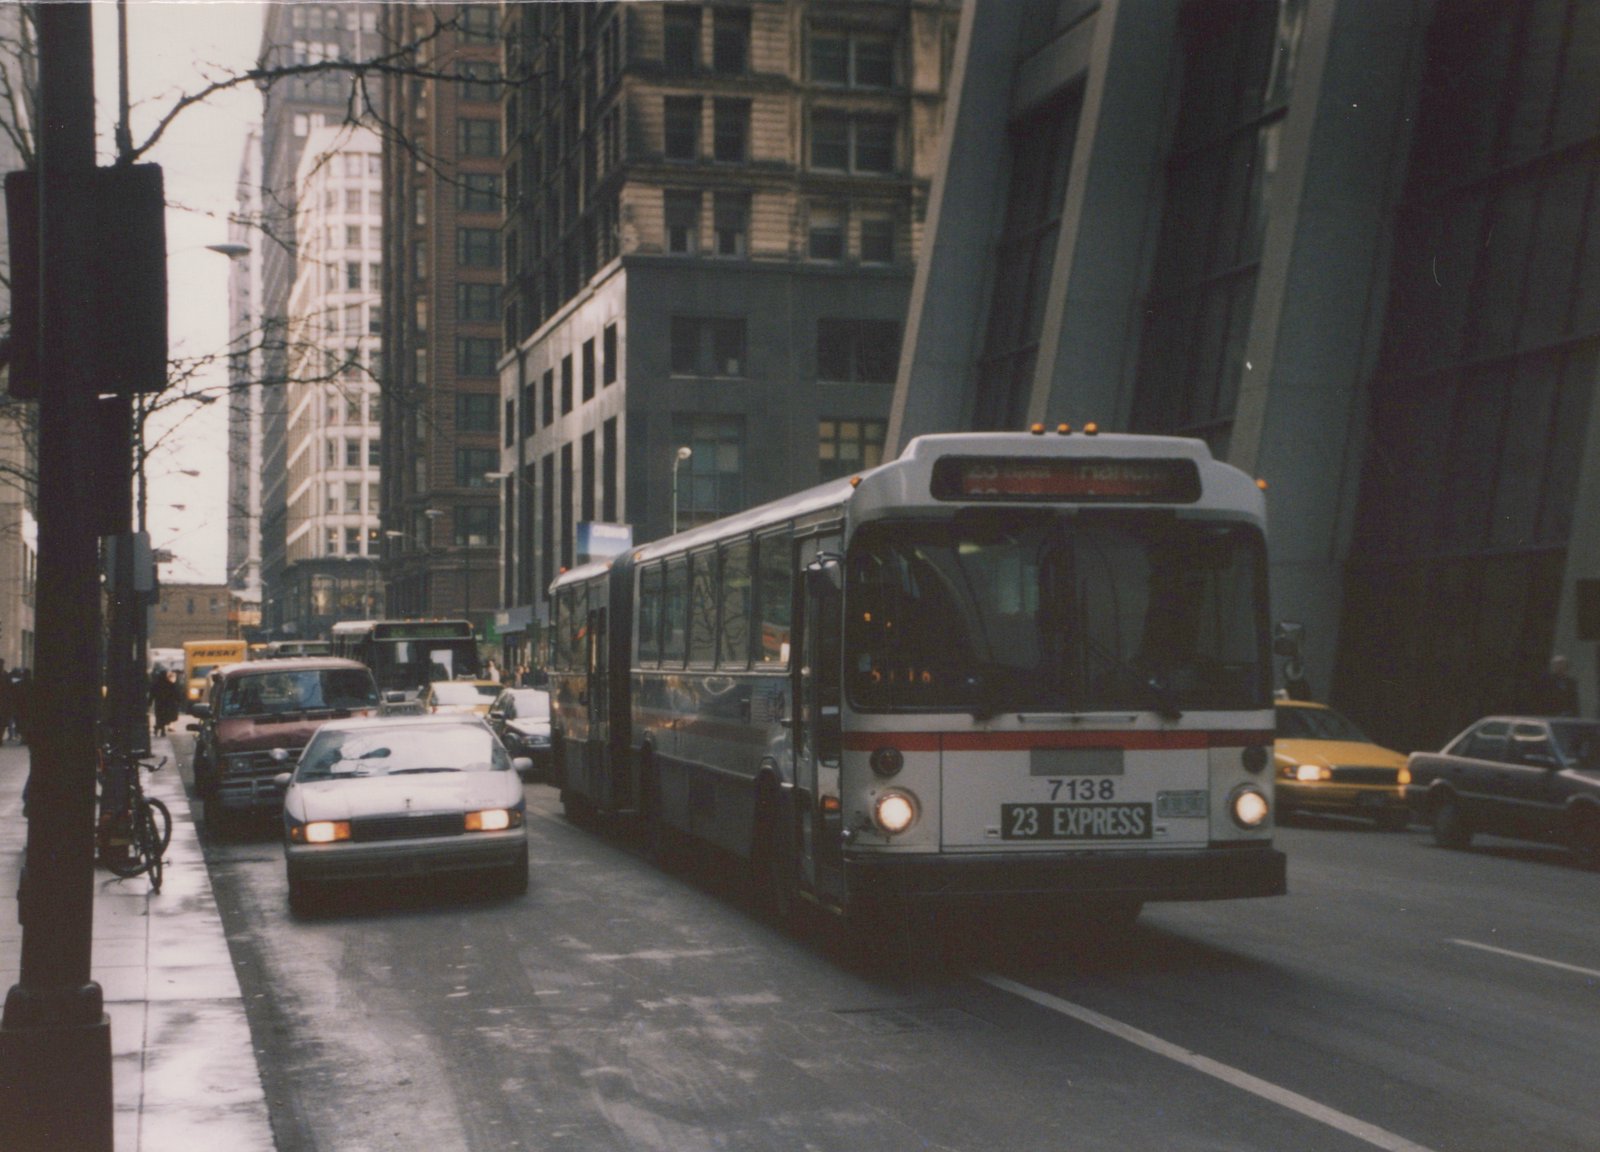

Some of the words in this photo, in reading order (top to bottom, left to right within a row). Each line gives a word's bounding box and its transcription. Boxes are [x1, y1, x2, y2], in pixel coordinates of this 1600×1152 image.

[1048, 779, 1115, 800] 7138
[1011, 807, 1039, 836] 23
[1053, 807, 1145, 836] EXPRESS
